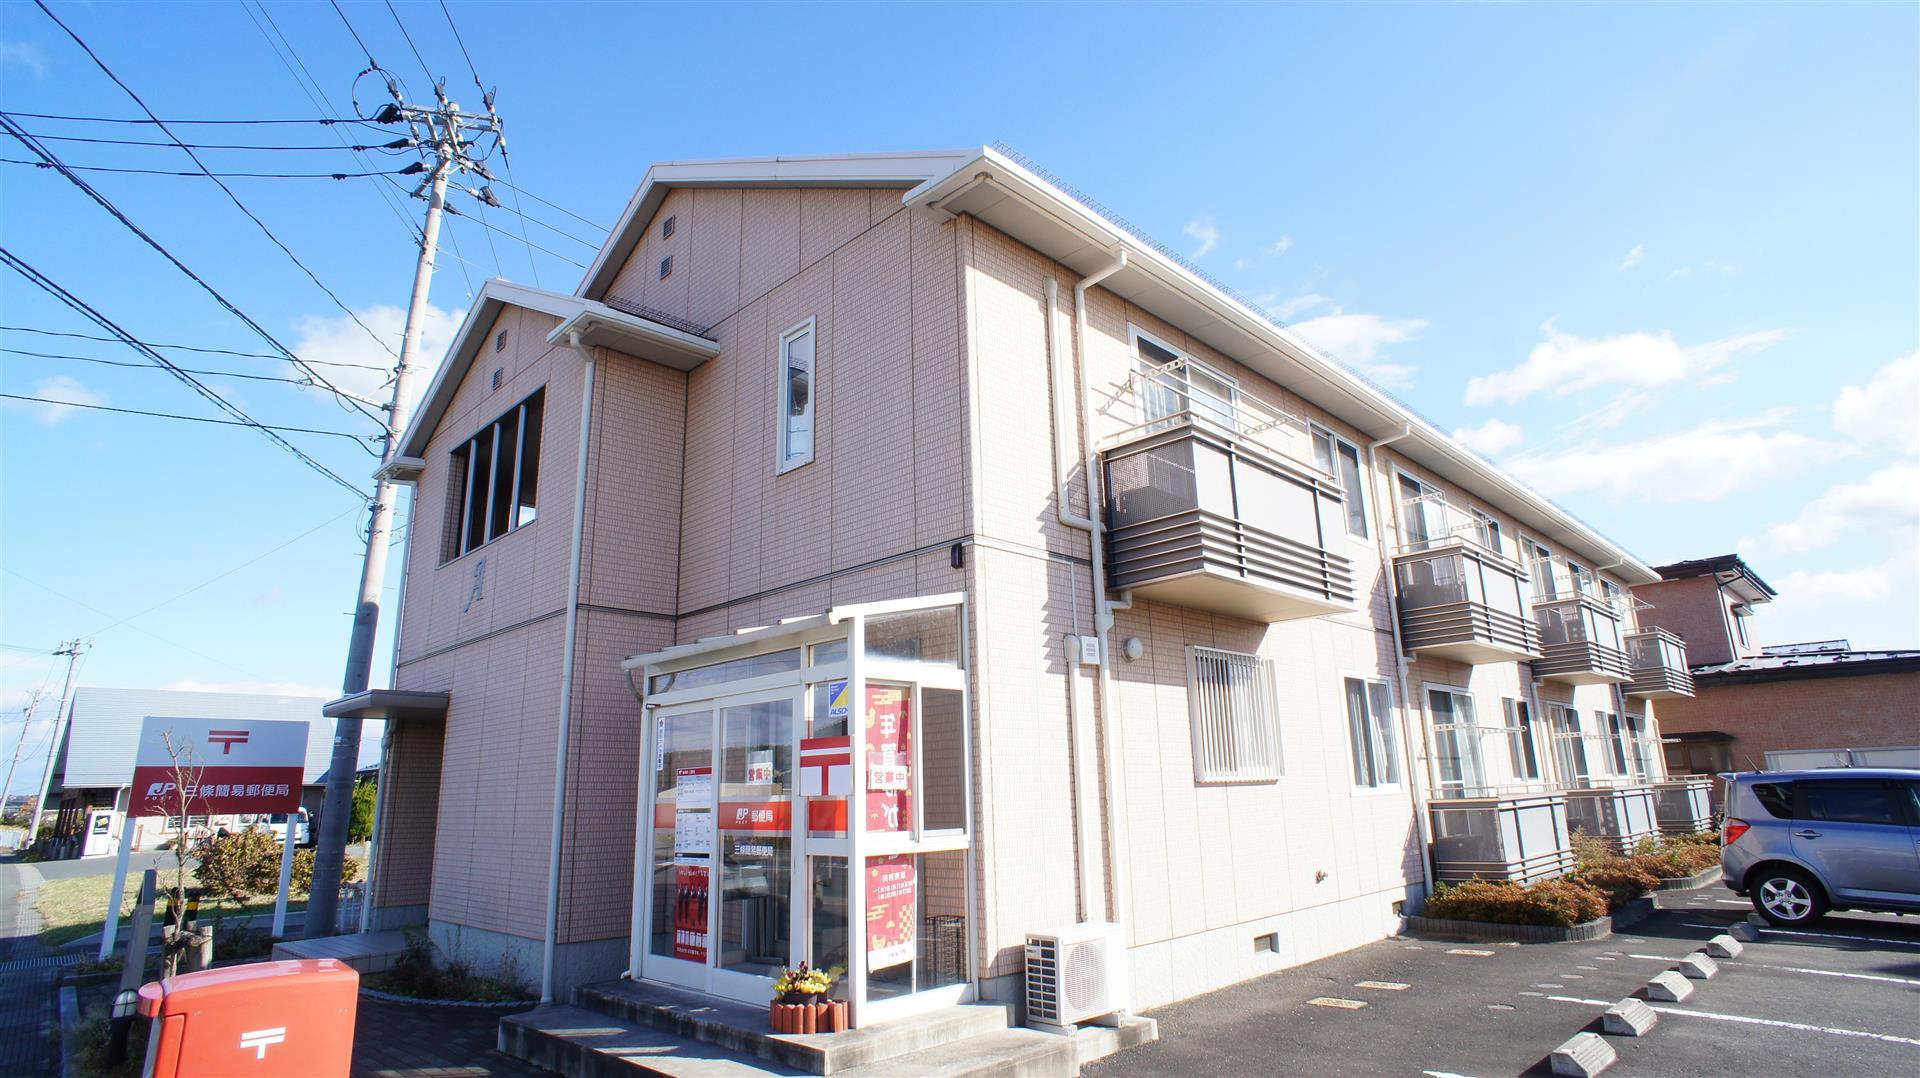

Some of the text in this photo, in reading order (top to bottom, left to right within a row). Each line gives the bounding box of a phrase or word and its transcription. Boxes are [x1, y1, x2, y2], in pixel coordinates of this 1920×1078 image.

[830, 707, 848, 716] ALSO
[748, 767, 771, 783] 営業中
[874, 771, 905, 785] 営業中
[184, 783, 290, 798] 三條簡易郵便局
[751, 809, 774, 823] 郵便局
